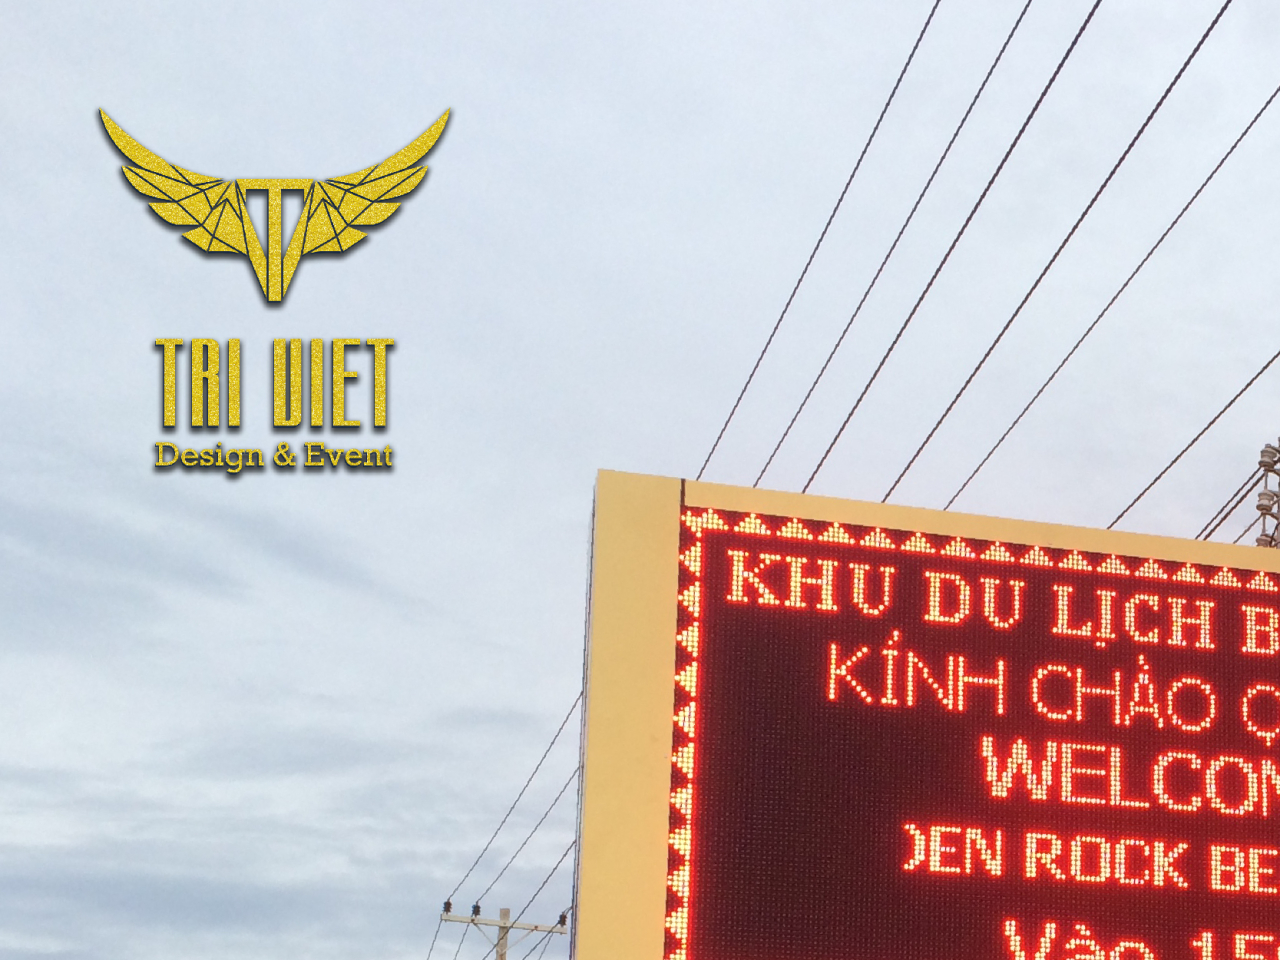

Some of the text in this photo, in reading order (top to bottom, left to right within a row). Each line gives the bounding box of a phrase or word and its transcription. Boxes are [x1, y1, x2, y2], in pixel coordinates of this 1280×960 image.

[726, 549, 896, 615] KHU
[924, 570, 1024, 629] DU
[1052, 584, 1216, 649] LỊCH
[827, 629, 1005, 715] KÍNH
[1031, 654, 1217, 732] CHÀO
[1025, 832, 1189, 888] ROCK
